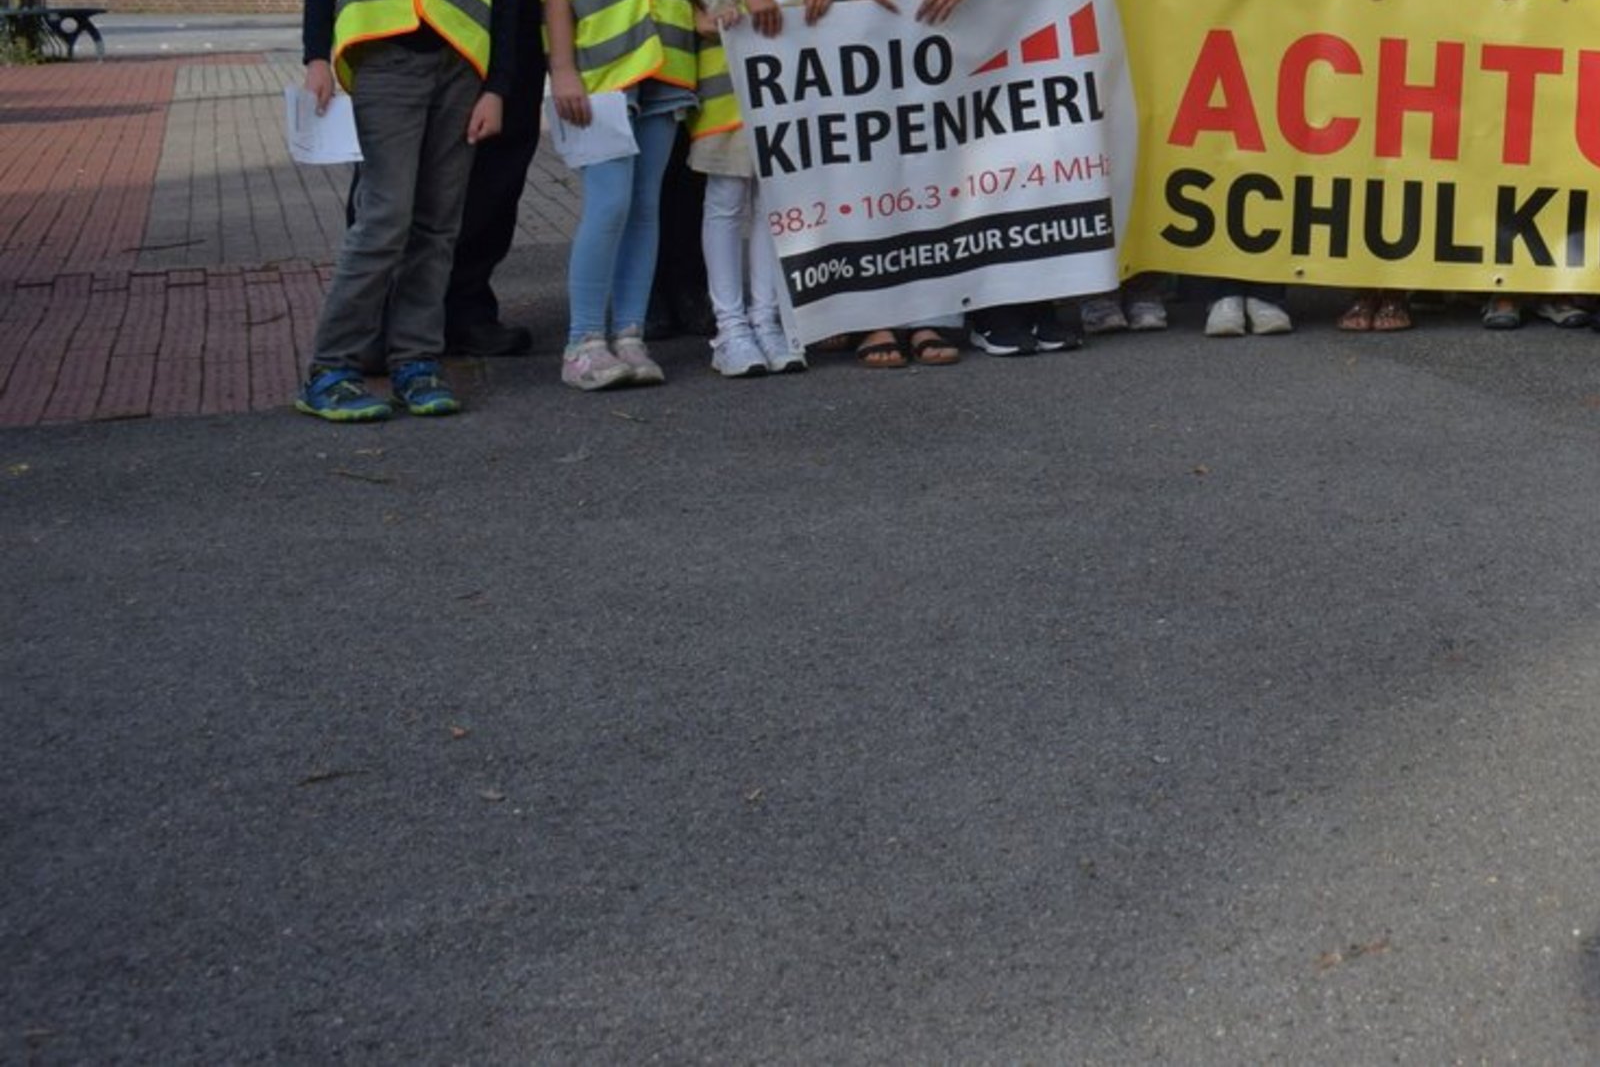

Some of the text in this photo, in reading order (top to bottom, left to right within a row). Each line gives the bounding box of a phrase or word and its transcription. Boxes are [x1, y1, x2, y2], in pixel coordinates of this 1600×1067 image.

[744, 34, 954, 110] RADIO
[754, 71, 1105, 178] KIEPENKERL
[860, 183, 942, 219] 106.3
[966, 162, 1047, 198] 107.4
[790, 213, 1113, 293] 100% SICHER ZUR SCHULE.
